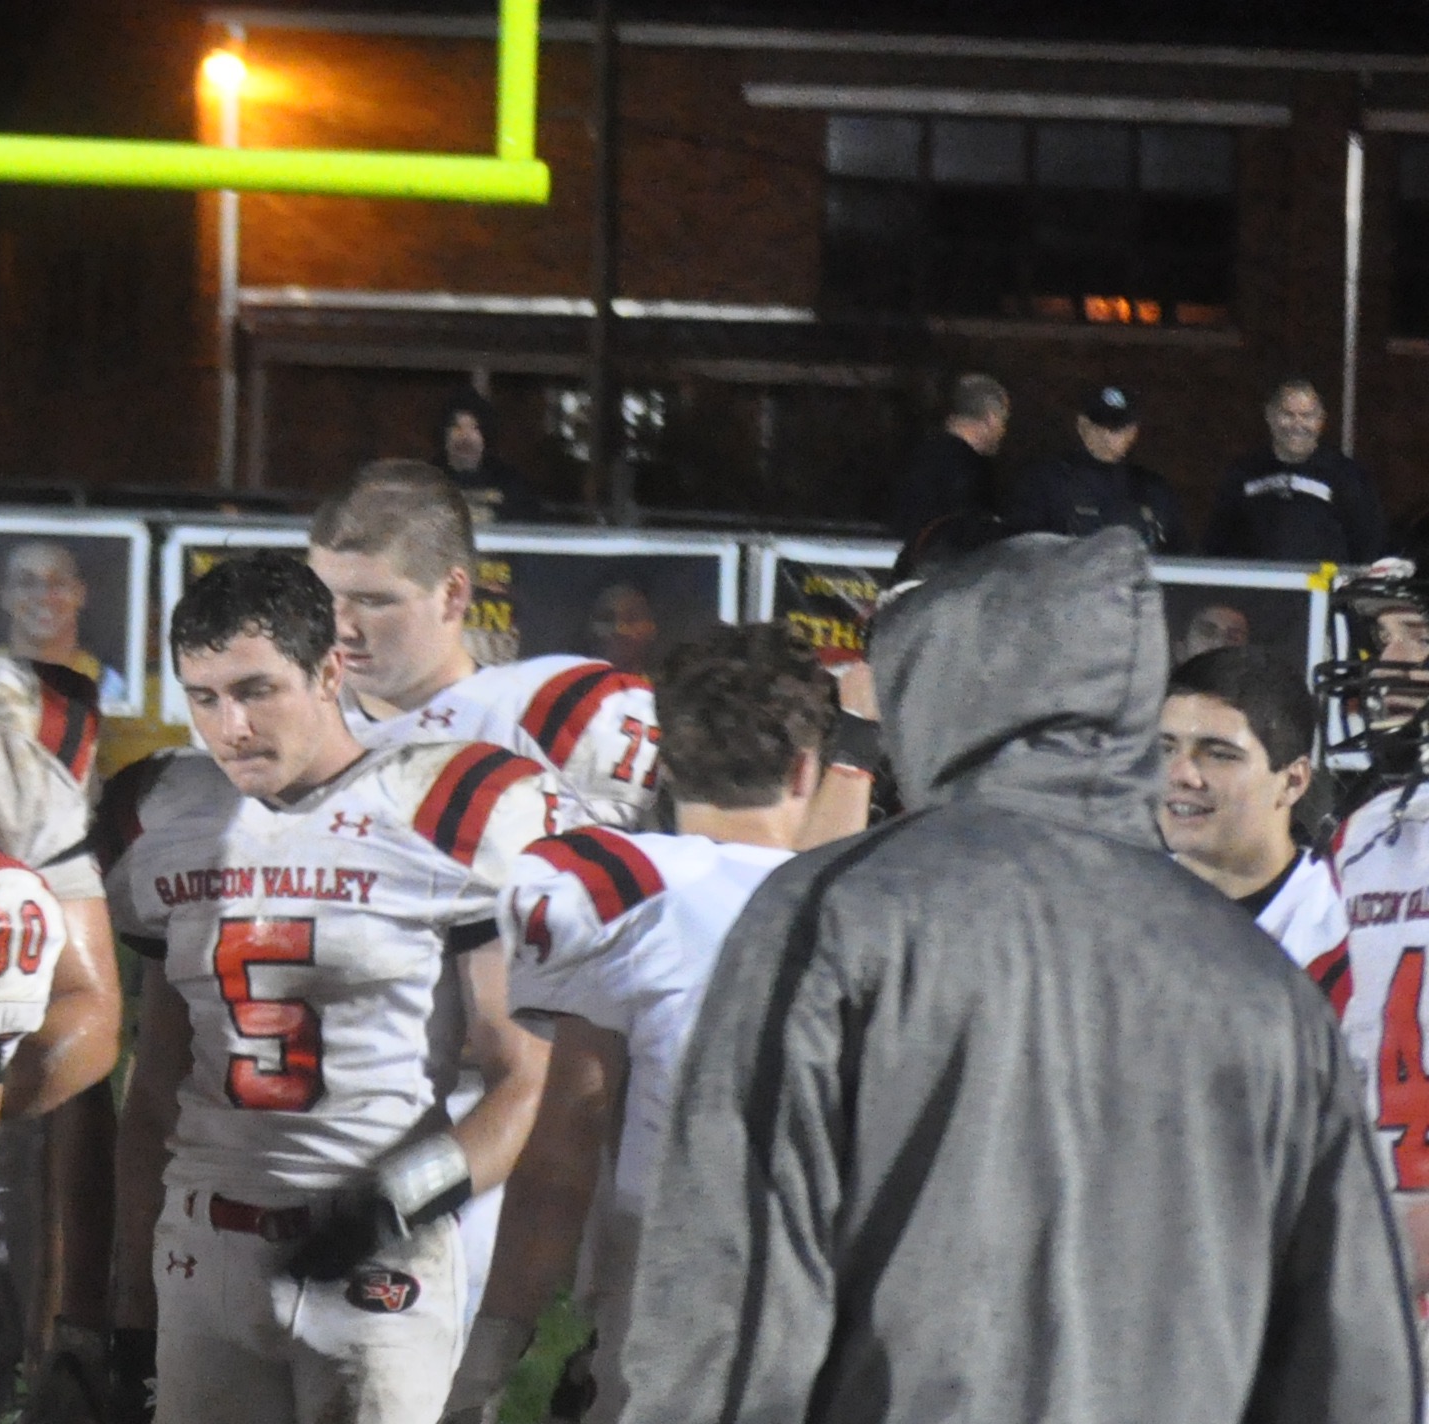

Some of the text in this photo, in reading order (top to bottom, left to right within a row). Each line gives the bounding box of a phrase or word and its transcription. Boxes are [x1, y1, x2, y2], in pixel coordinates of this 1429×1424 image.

[155, 867, 378, 907] SAUCON VALLEY
[214, 915, 327, 1112] 5
